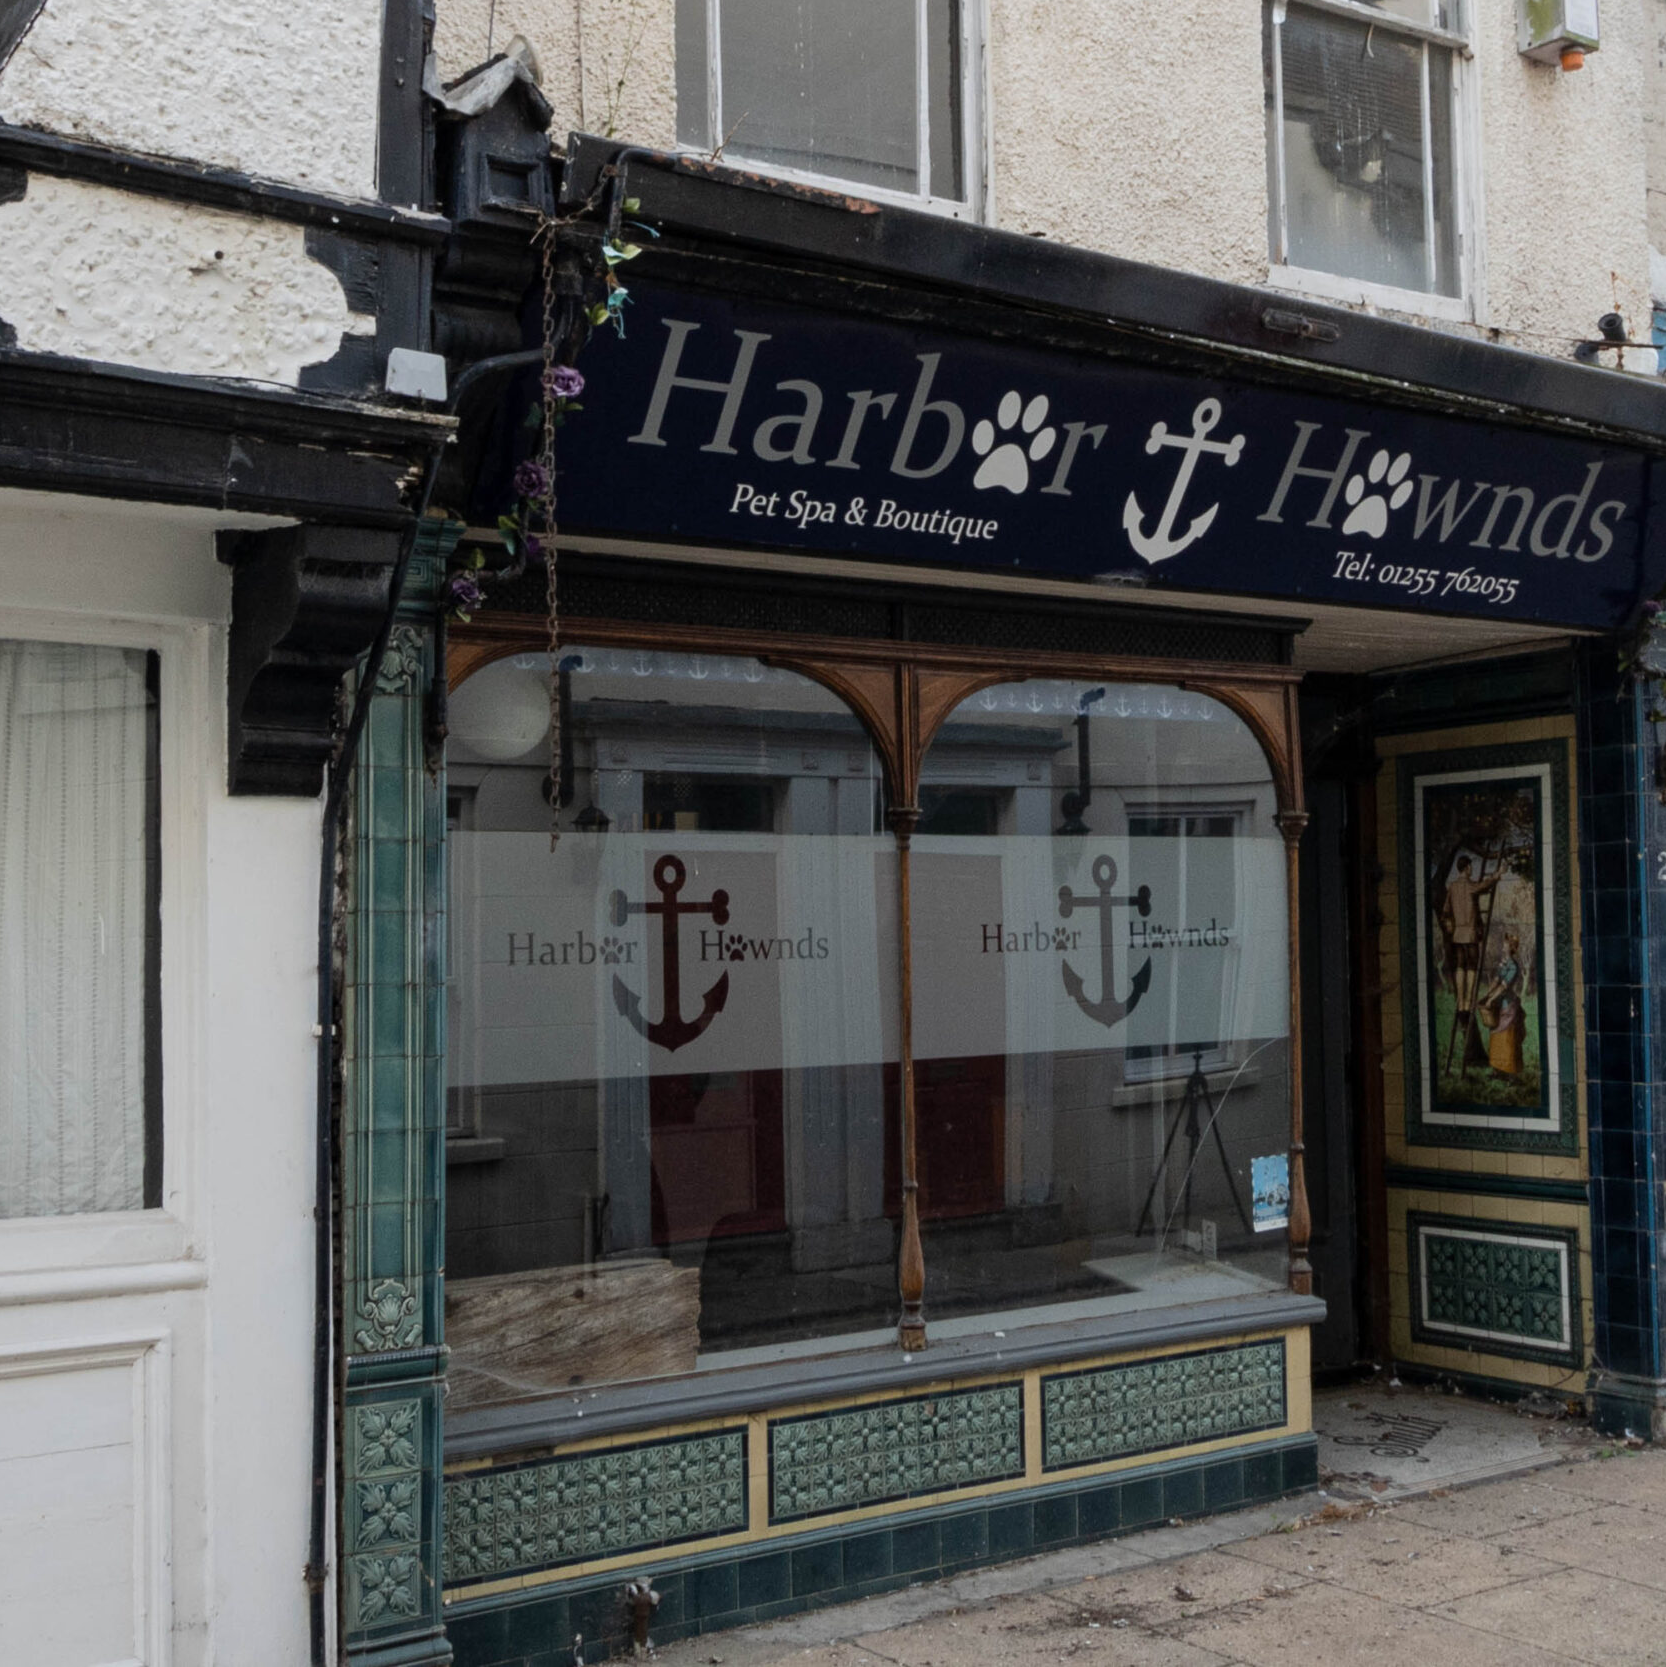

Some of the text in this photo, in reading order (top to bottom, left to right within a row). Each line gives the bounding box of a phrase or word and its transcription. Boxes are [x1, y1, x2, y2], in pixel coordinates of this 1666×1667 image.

[627, 318, 1627, 563] Harbr Hwnds
[730, 483, 999, 545] Pet Spa & Boutique
[1332, 551, 1520, 604] Tel: 01255 762055
[507, 927, 830, 967] Harbr Hwnds
[981, 918, 1230, 955] Harbr Hwnds
